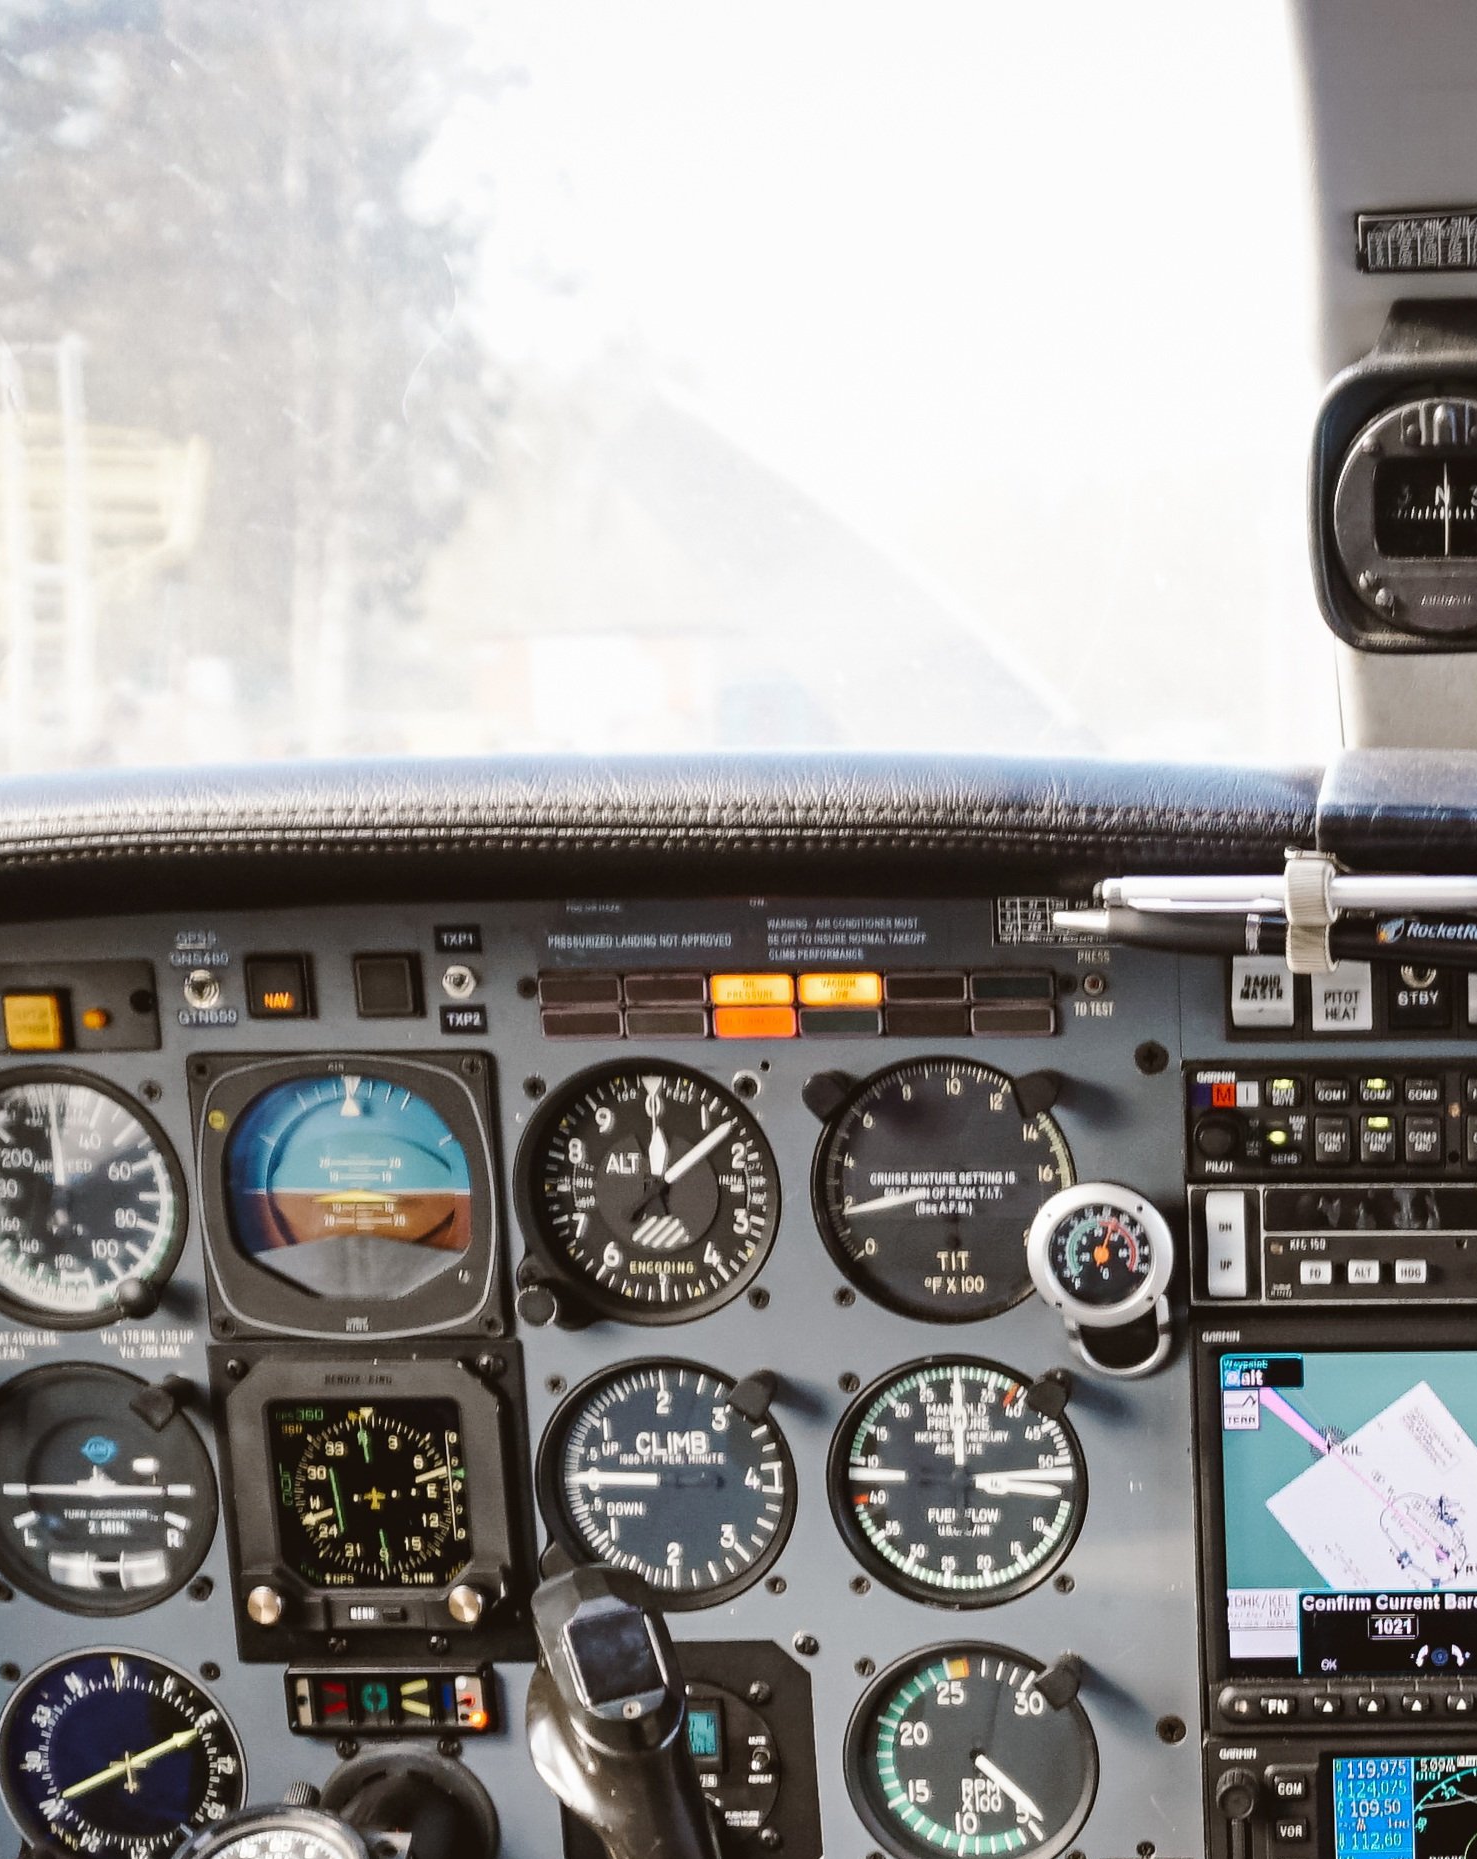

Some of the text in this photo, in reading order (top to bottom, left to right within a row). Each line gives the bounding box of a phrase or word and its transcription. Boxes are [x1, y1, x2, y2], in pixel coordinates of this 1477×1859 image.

[767, 918, 807, 930] WARNING
[832, 917, 892, 930] CONDITIONER
[894, 917, 918, 929] MUST
[548, 934, 732, 948] PRESSURIZED LANDING NOT APPROVED
[800, 933, 811, 945] TO
[814, 933, 846, 945] INSURE
[888, 932, 927, 945] TAKEOFF
[797, 948, 864, 961] PERFORMANCE
[1078, 952, 1110, 963] PRESS
[264, 993, 290, 1008] NAV
[1324, 991, 1359, 1006] PITOT
[1397, 991, 1438, 1006] STBY
[1075, 1002, 1088, 1016] TO
[1325, 1007, 1357, 1021] HEAT
[607, 1153, 639, 1173] ALT
[1205, 1161, 1234, 1172] PILOT
[870, 1172, 908, 1186] CRUISE
[911, 1172, 956, 1185] MIXTURE
[959, 1171, 1002, 1185] SETTING
[630, 1261, 693, 1275] ENCODING
[937, 1251, 969, 1271] TIT
[947, 1275, 985, 1294] X 100
[1202, 1331, 1239, 1343] GARMIN
[635, 1431, 707, 1455] CLIMB
[1342, 1444, 1363, 1456] KIL
[606, 1503, 644, 1516] DOWN
[1303, 1595, 1371, 1611] Confirm
[1376, 1595, 1440, 1611] Current
[1375, 1618, 1412, 1635] 1021
[936, 1682, 965, 1706] 25
[1015, 1691, 1044, 1716] 30
[1268, 1699, 1287, 1714] FN
[899, 1721, 928, 1746] 20
[1219, 1748, 1257, 1760] GARMIN
[907, 1780, 930, 1802] 15
[1278, 1783, 1302, 1796] COM
[1280, 1825, 1303, 1838] VOR
